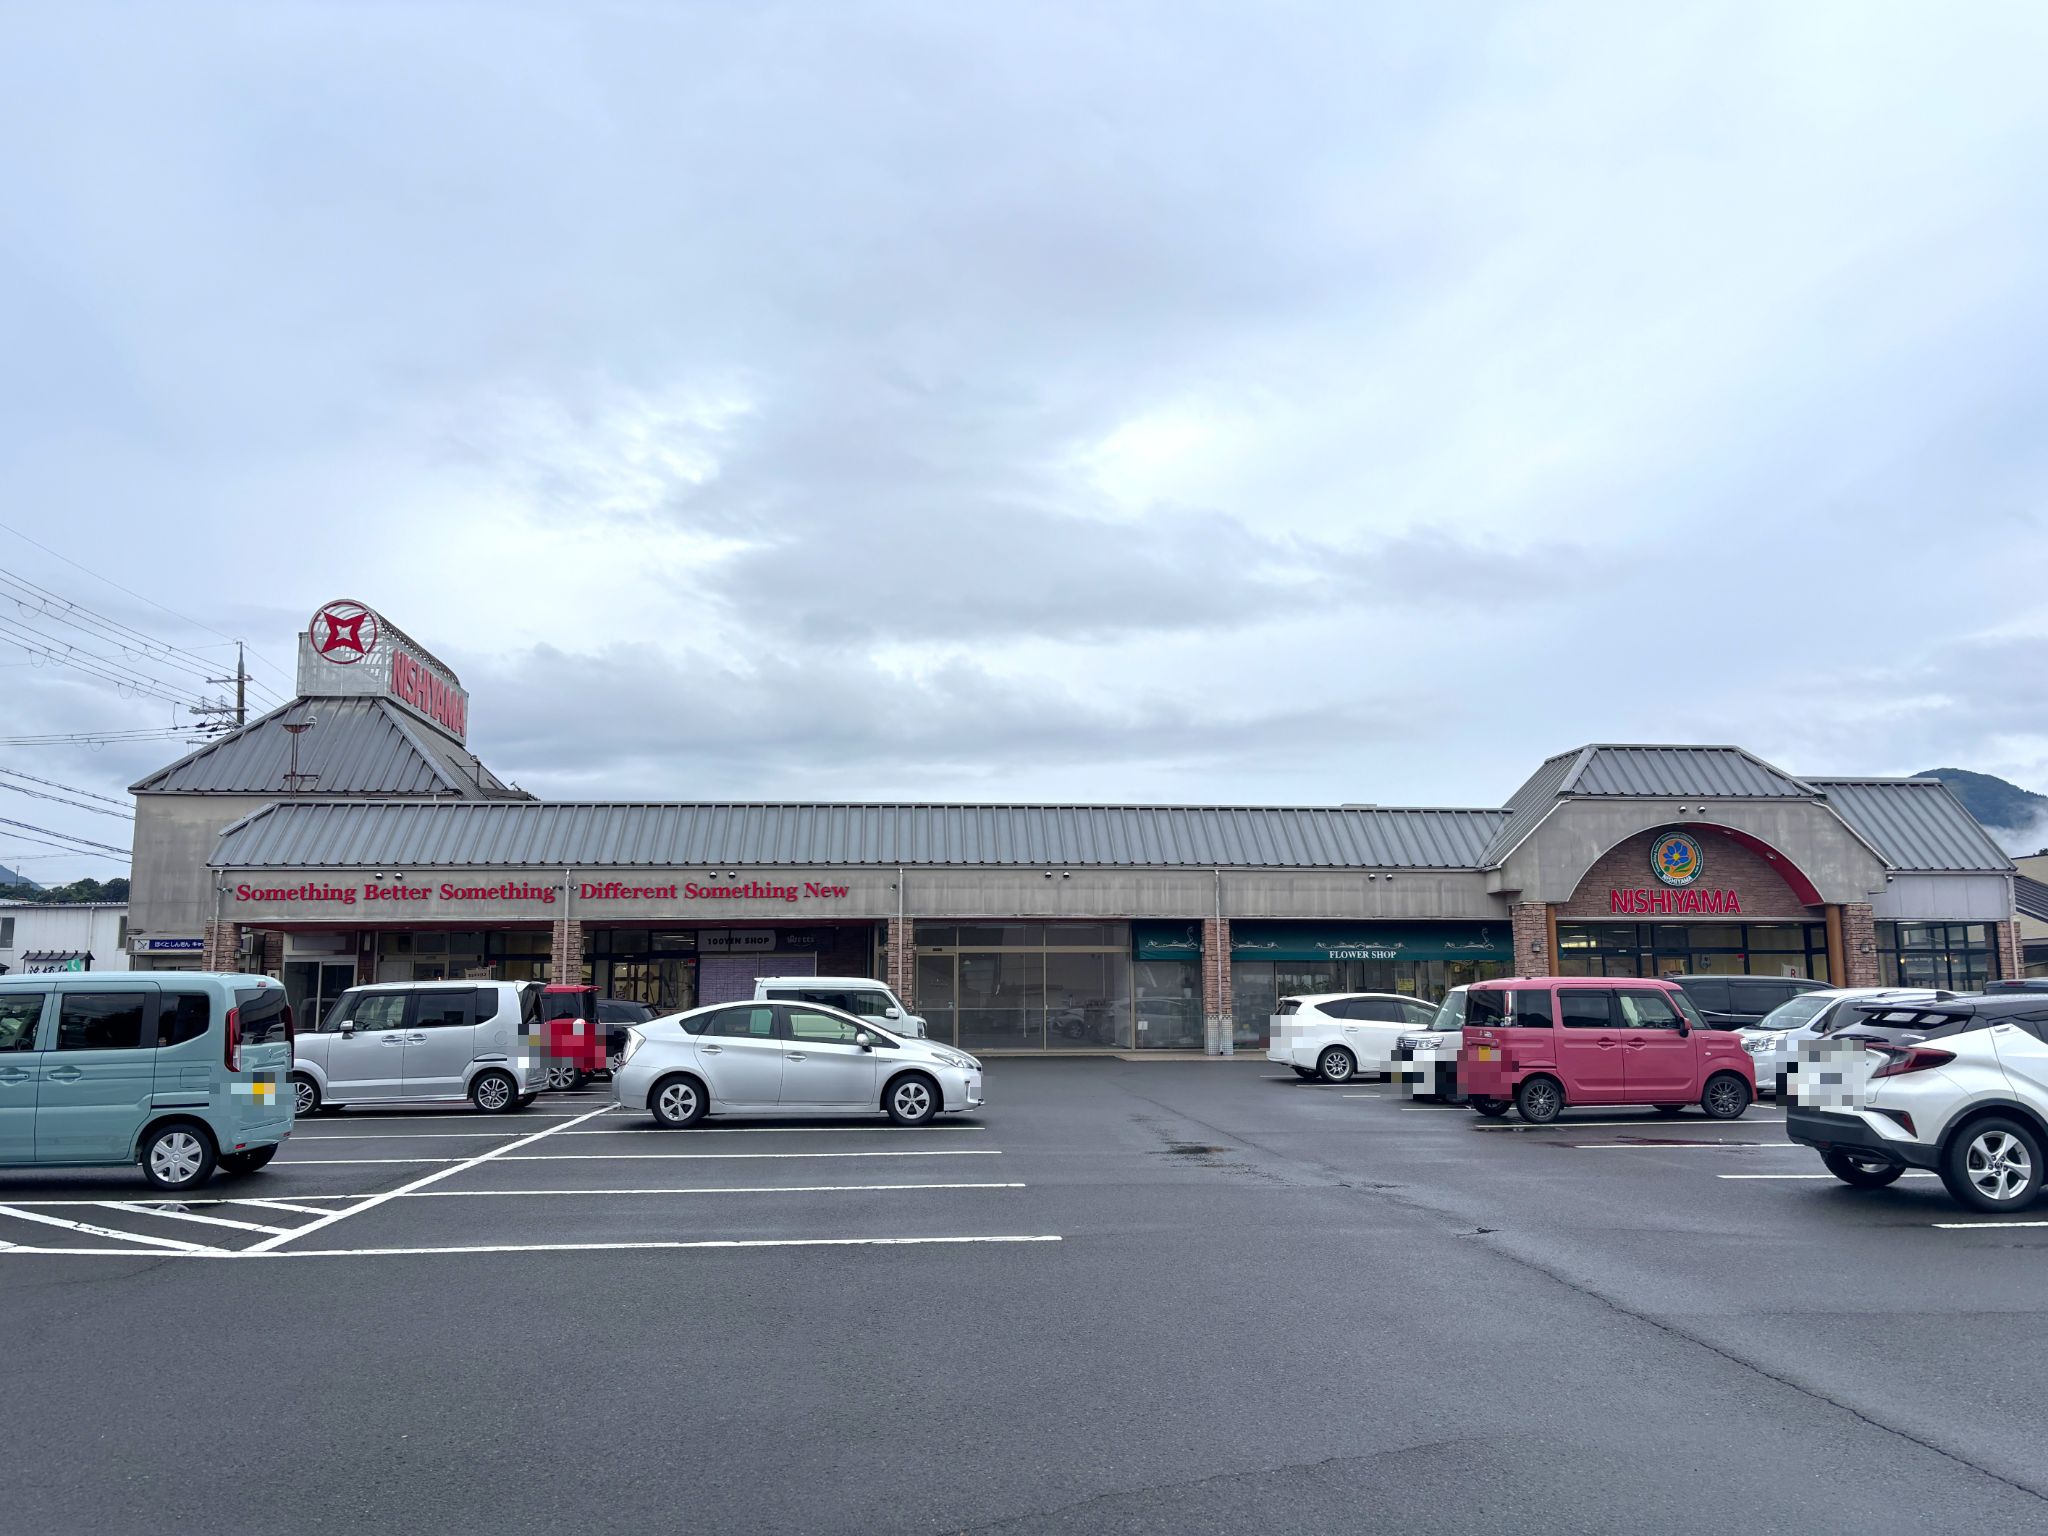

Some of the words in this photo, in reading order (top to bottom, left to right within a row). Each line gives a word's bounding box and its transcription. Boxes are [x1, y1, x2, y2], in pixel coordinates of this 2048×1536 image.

[391, 648, 464, 737] NISHIYAMA
[236, 883, 356, 904] Something
[363, 884, 432, 900] Better
[439, 882, 556, 903] Something
[580, 882, 677, 899] Different
[684, 881, 798, 902] Something
[804, 882, 849, 898] New
[1611, 888, 1742, 914] NISHIYAMA
[745, 937, 769, 945] SHOP
[1329, 950, 1369, 959] FLOWER
[1371, 950, 1396, 959] SHOP
